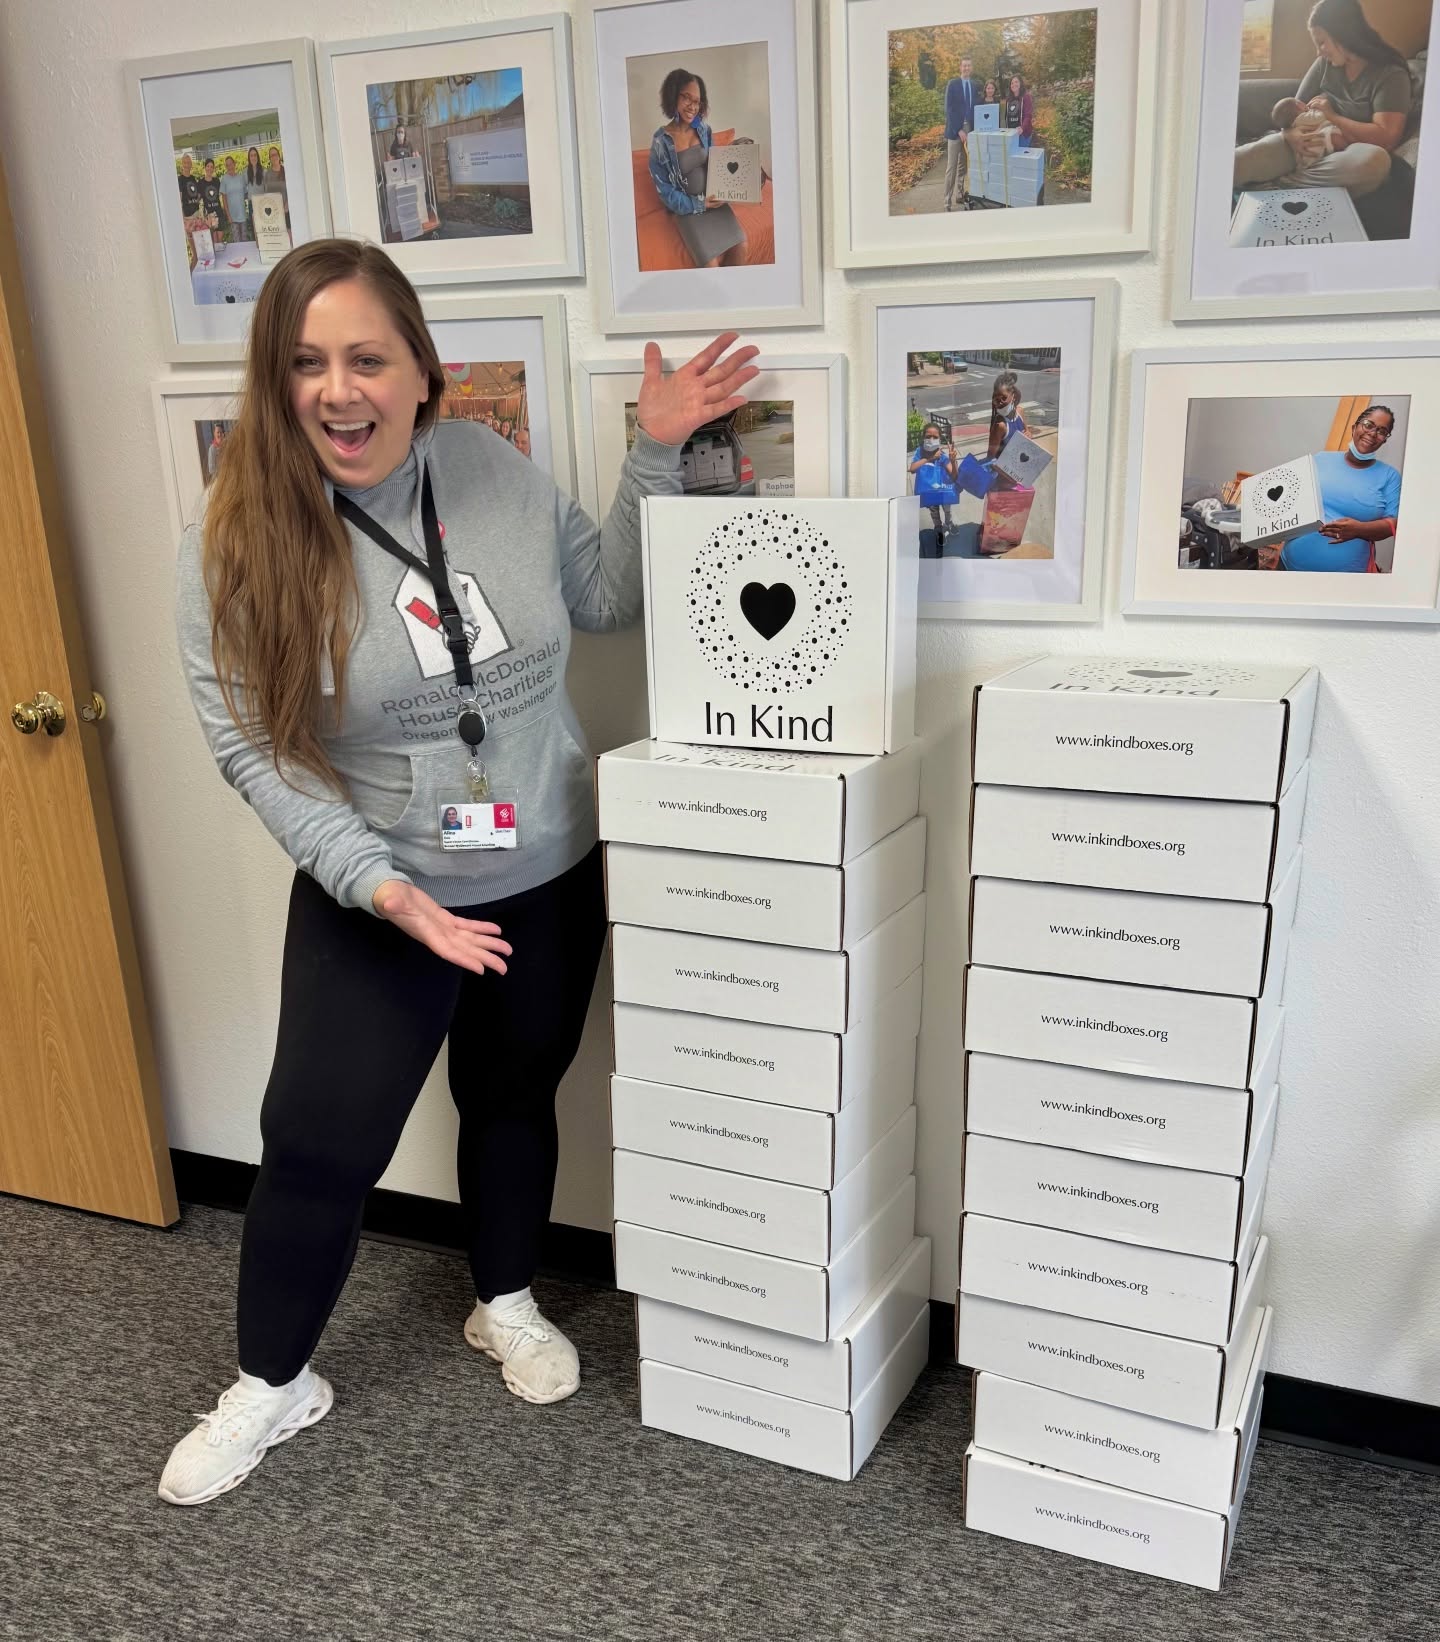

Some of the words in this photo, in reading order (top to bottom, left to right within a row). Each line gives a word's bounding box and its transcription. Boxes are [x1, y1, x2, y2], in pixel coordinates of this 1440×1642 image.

[727, 190, 748, 200] Kind
[1285, 232, 1334, 246] Kind
[1256, 525, 1267, 537] In
[1271, 513, 1299, 532] Kind
[476, 665, 553, 709] Charities
[1050, 683, 1090, 691] In
[1108, 685, 1220, 696] Kind
[402, 726, 458, 740] Oregon
[498, 680, 557, 720] Washington
[705, 701, 735, 736] In
[751, 704, 833, 743] Kind
[1055, 733, 1193, 755] www.inkindboxes.org
[655, 754, 689, 762] In
[701, 758, 795, 771] Kind
[658, 800, 767, 821] www.inkindboxes.org
[1051, 832, 1185, 856] www.inkindboxes.org
[665, 886, 771, 909] www.inkindboxes.org
[1049, 924, 1180, 950] www.inkindboxes.org
[674, 968, 779, 992] www.inkindboxes.org
[1040, 1014, 1168, 1042] www.inkindboxes.org
[673, 1045, 774, 1071] www.inkindboxes.org
[1040, 1099, 1166, 1129] www.inkindboxes.org
[669, 1119, 768, 1148] www.inkindboxes.org
[669, 1192, 765, 1223] www.inkindboxes.org
[1036, 1181, 1159, 1214] www.inkindboxes.org
[671, 1266, 766, 1298] www.inkindboxes.org
[1027, 1261, 1148, 1295] www.inkindboxes.org
[694, 1333, 789, 1367] www.inkindboxes.org
[1027, 1341, 1144, 1379] www.inkindboxes.org
[696, 1403, 791, 1438] www.inkindboxes.org
[1043, 1423, 1161, 1463] www.inkindboxes.org
[1034, 1506, 1151, 1544] www.inkindboxes.org
